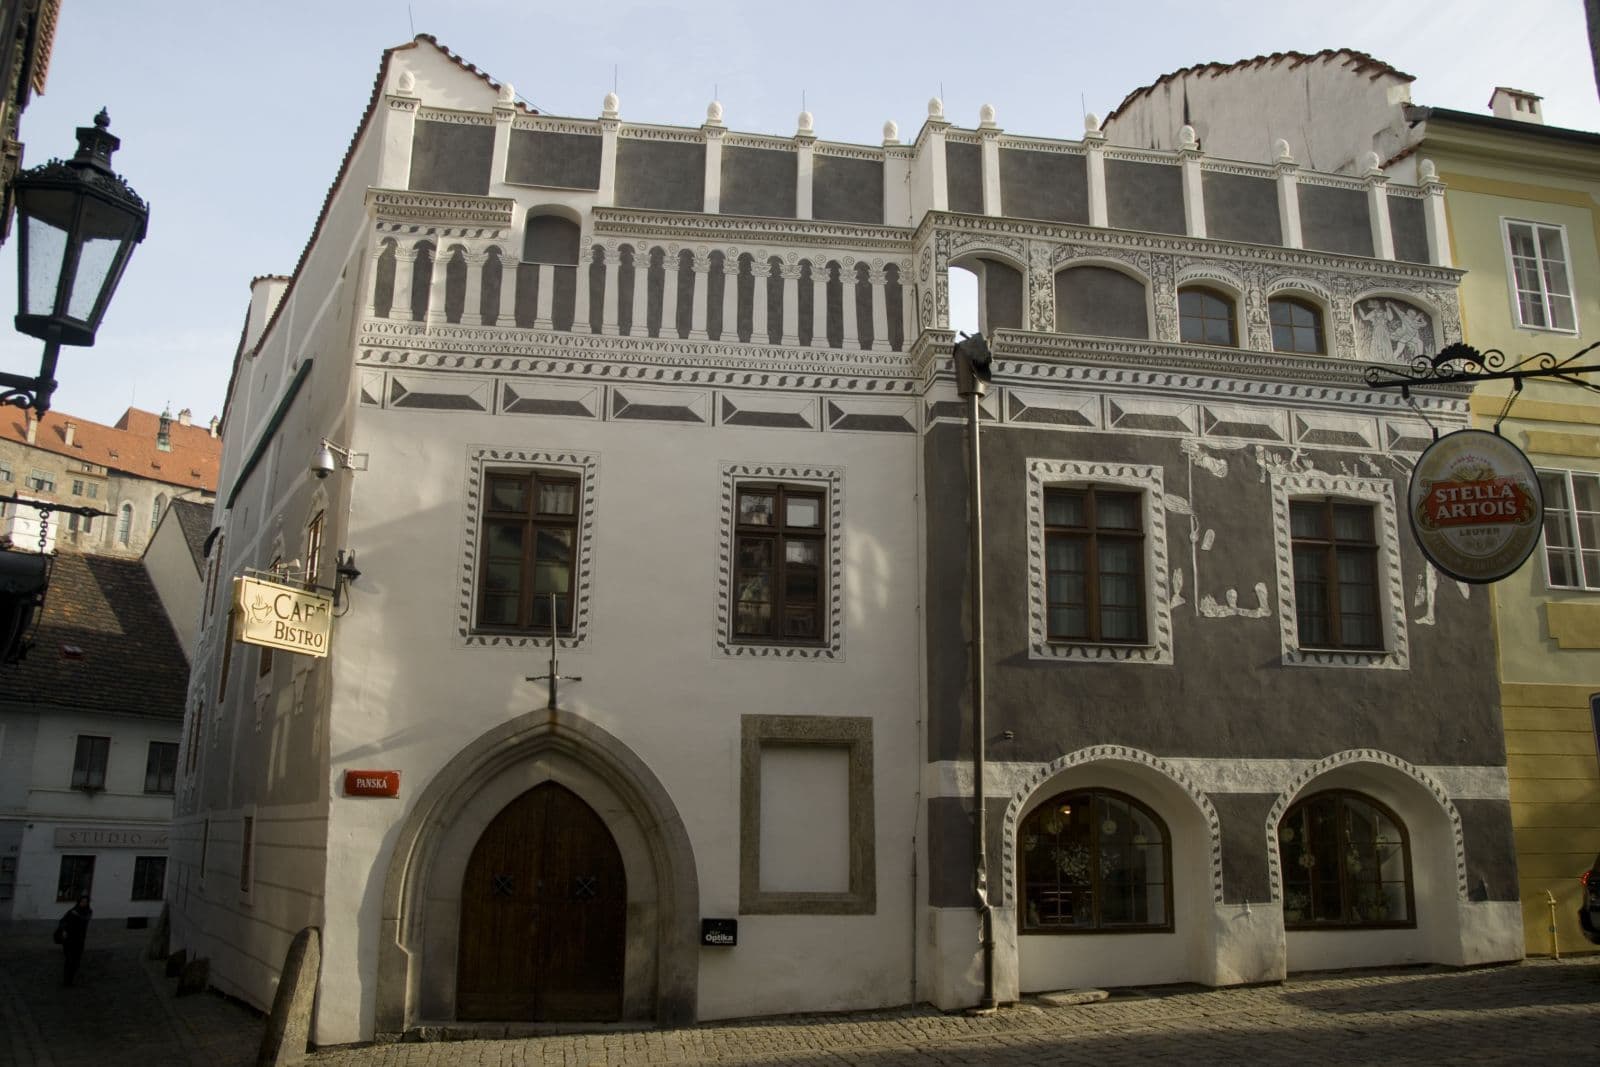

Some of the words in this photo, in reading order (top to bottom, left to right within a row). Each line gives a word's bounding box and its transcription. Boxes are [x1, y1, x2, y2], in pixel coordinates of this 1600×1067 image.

[1435, 482, 1515, 502] STELLA
[1436, 500, 1517, 520] ARTOIS
[356, 776, 387, 789] PANSKÁ
[69, 831, 142, 845] STUDIO
[705, 933, 734, 943] Optika
